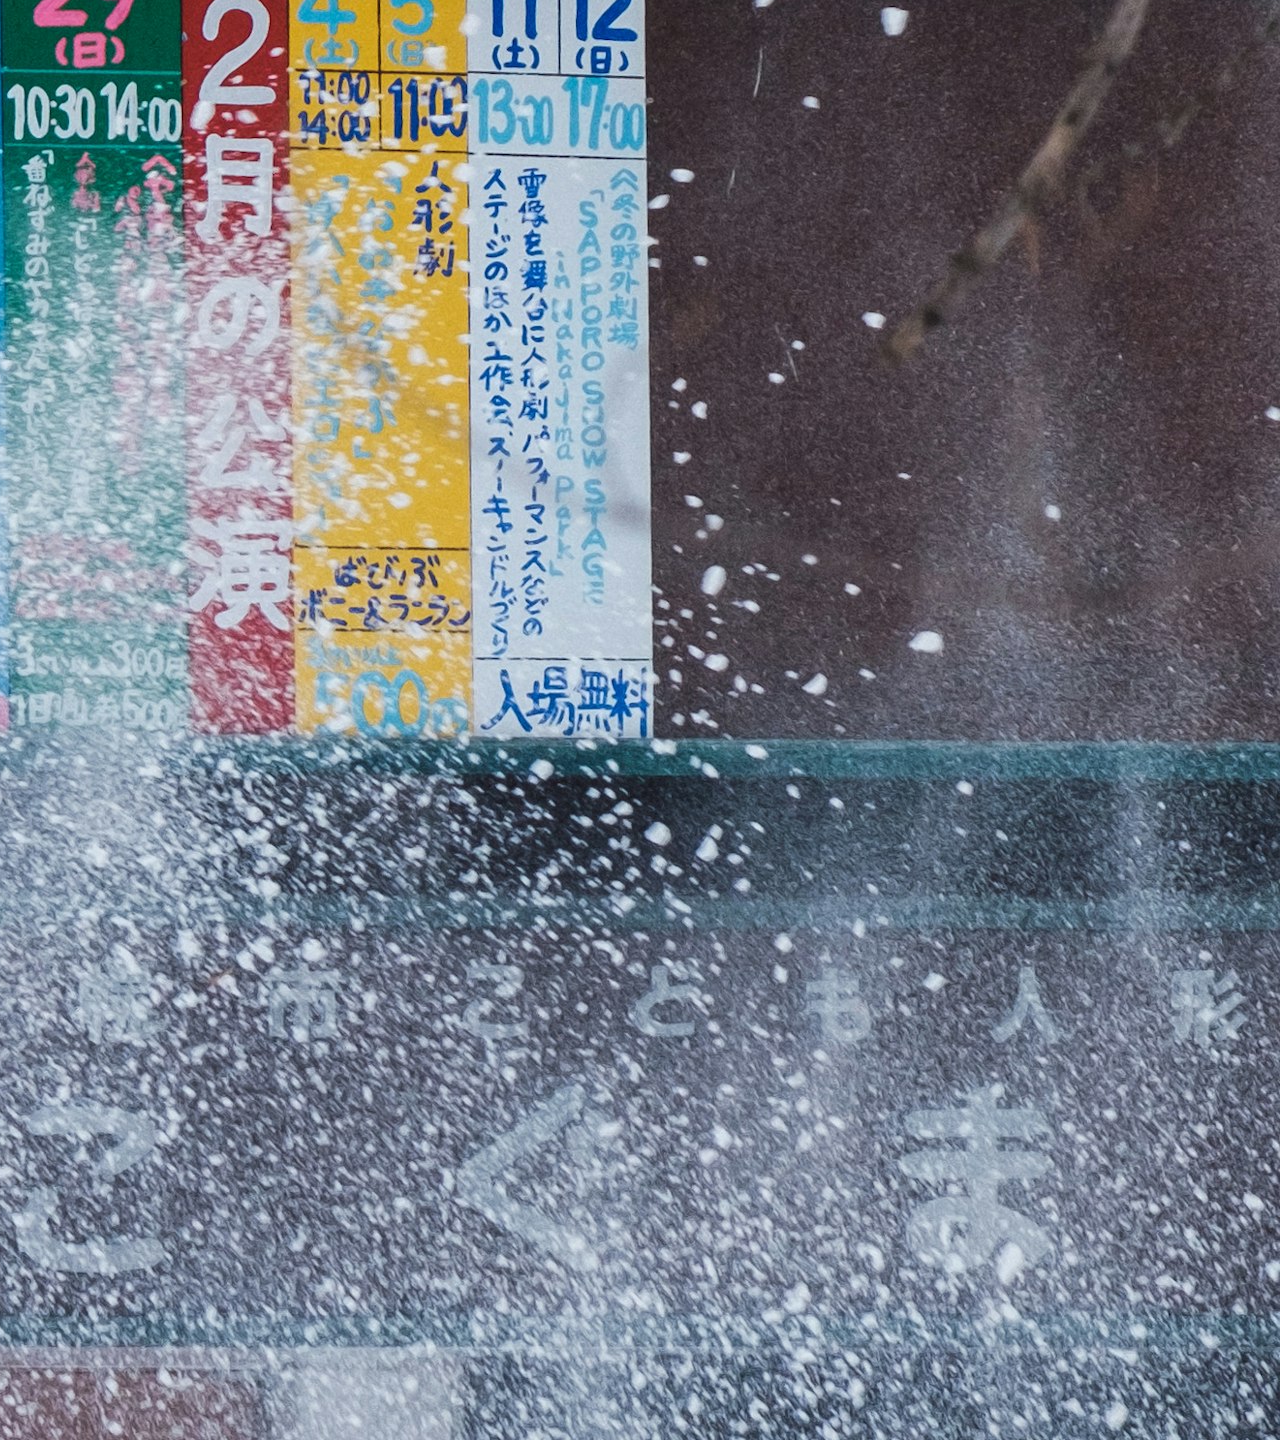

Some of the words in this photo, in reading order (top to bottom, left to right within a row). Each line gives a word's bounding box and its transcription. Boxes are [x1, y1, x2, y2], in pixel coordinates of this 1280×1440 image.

[55, 32, 125, 68] (日)
[304, 37, 360, 69] (土)
[387, 39, 440, 68] (日
[492, 37, 540, 70] (土)
[575, 45, 629, 74] (日)
[299, 70, 371, 105] 11:00
[7, 83, 95, 140] 10:30
[100, 81, 182, 142] 14:00
[298, 109, 371, 145] 14:00
[387, 76, 468, 142] 11:00
[473, 78, 554, 146] 13:00
[561, 76, 645, 152] 17:00
[413, 160, 456, 277] 人形劇
[581, 478, 607, 604] STAGE
[480, 666, 650, 738] 入場無料
